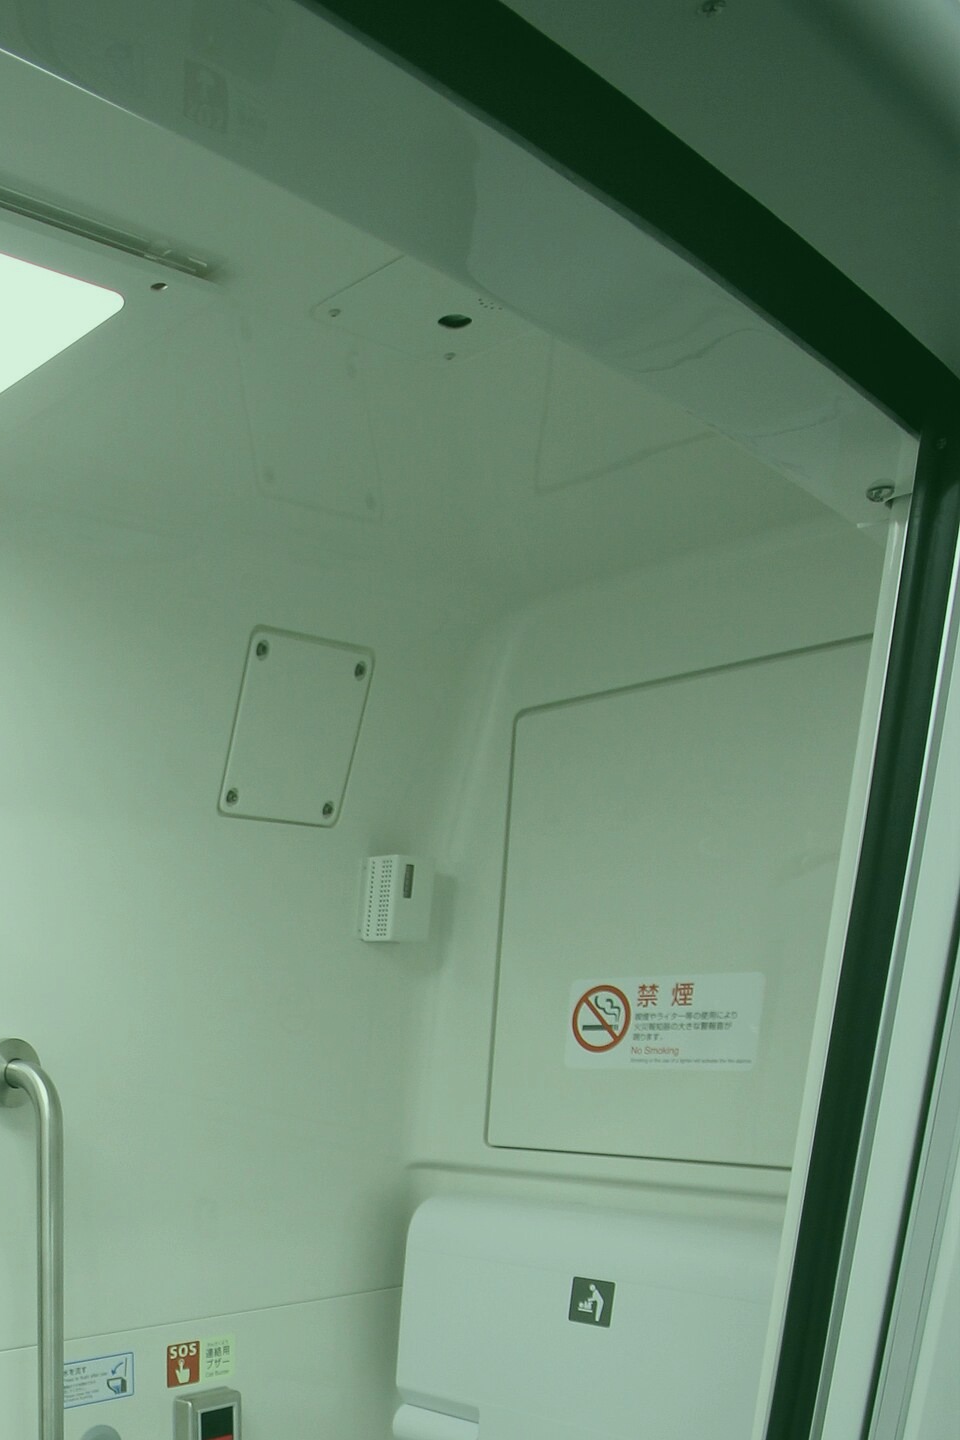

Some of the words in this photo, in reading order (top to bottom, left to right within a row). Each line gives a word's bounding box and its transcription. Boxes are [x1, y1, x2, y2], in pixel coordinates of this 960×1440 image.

[631, 1046, 642, 1055] No
[644, 1046, 679, 1057] Smoking
[169, 1343, 197, 1360] SOS
[206, 1345, 230, 1358] 連絡用
[206, 1358, 230, 1370] ブザー
